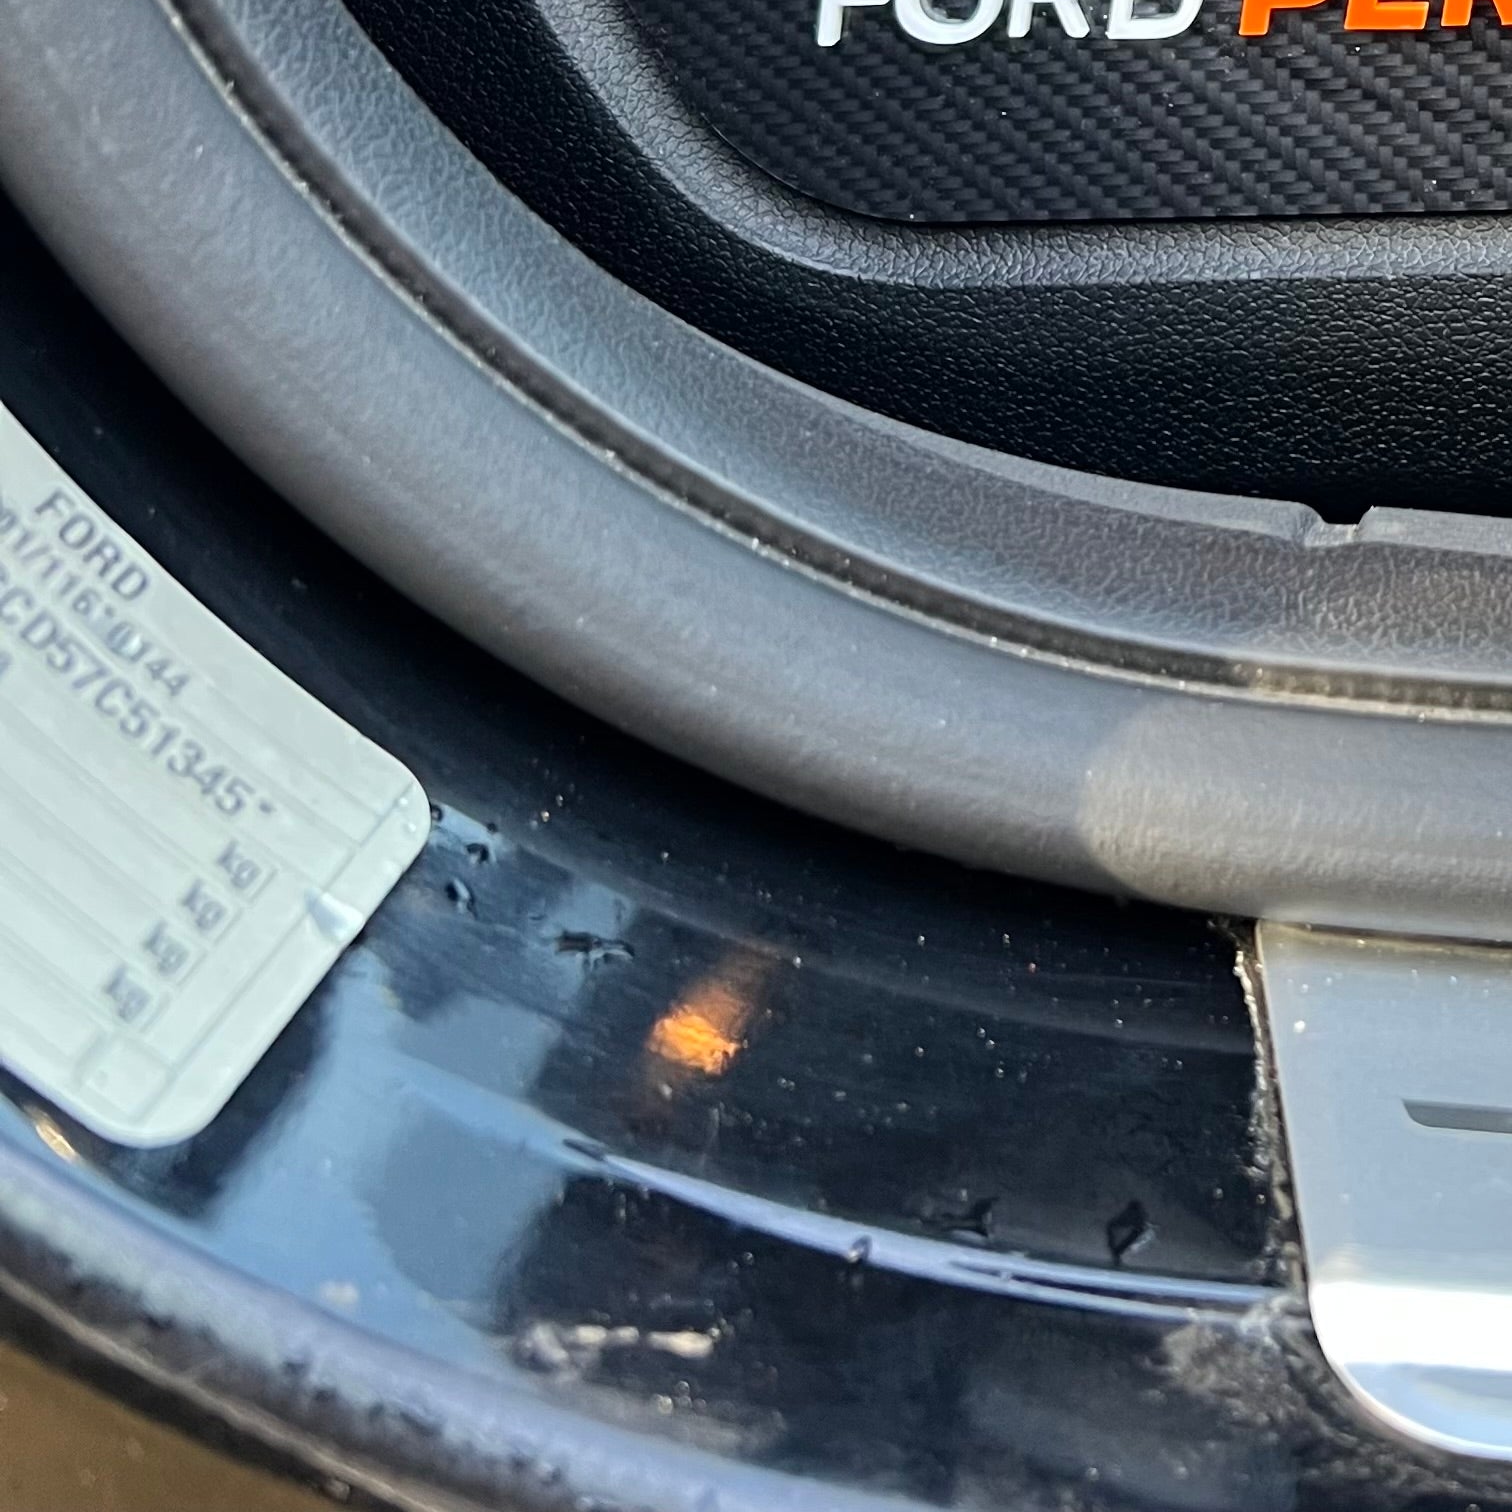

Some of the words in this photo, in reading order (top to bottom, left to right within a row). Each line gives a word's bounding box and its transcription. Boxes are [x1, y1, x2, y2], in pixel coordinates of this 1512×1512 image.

[34, 489, 149, 602] FORD
[0, 558, 276, 816] CD57C51345
[217, 839, 262, 891] kg
[181, 877, 228, 933] kg
[143, 919, 190, 978] kg
[104, 962, 151, 1024] kg
